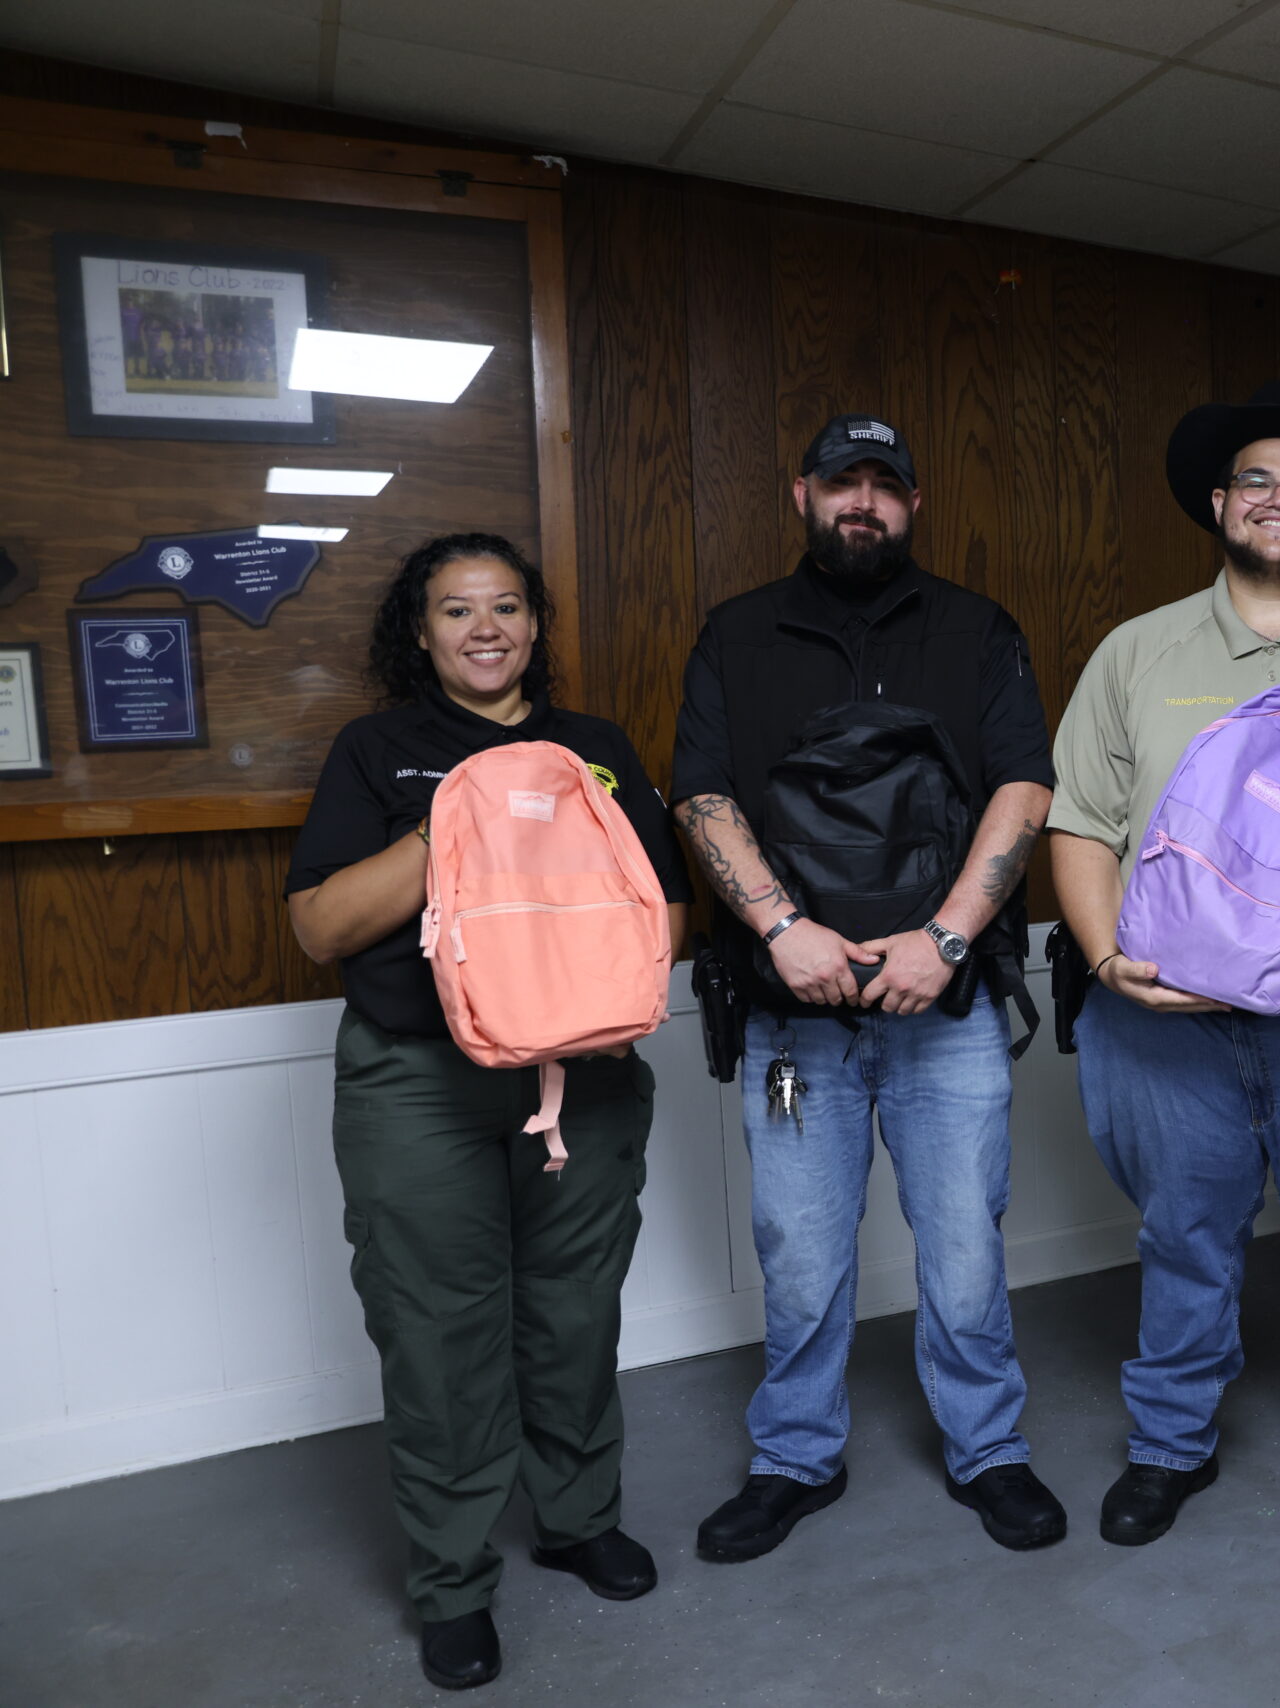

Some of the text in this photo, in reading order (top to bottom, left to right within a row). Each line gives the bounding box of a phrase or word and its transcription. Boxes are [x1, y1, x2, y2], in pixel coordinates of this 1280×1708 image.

[117, 260, 180, 287] Lions
[188, 266, 241, 290] Club
[850, 432, 895, 446] SHERIFF
[214, 546, 287, 560] Warrenton Lions Club
[1164, 695, 1234, 706] TRANSPORTATION
[396, 768, 421, 779] ASST.
